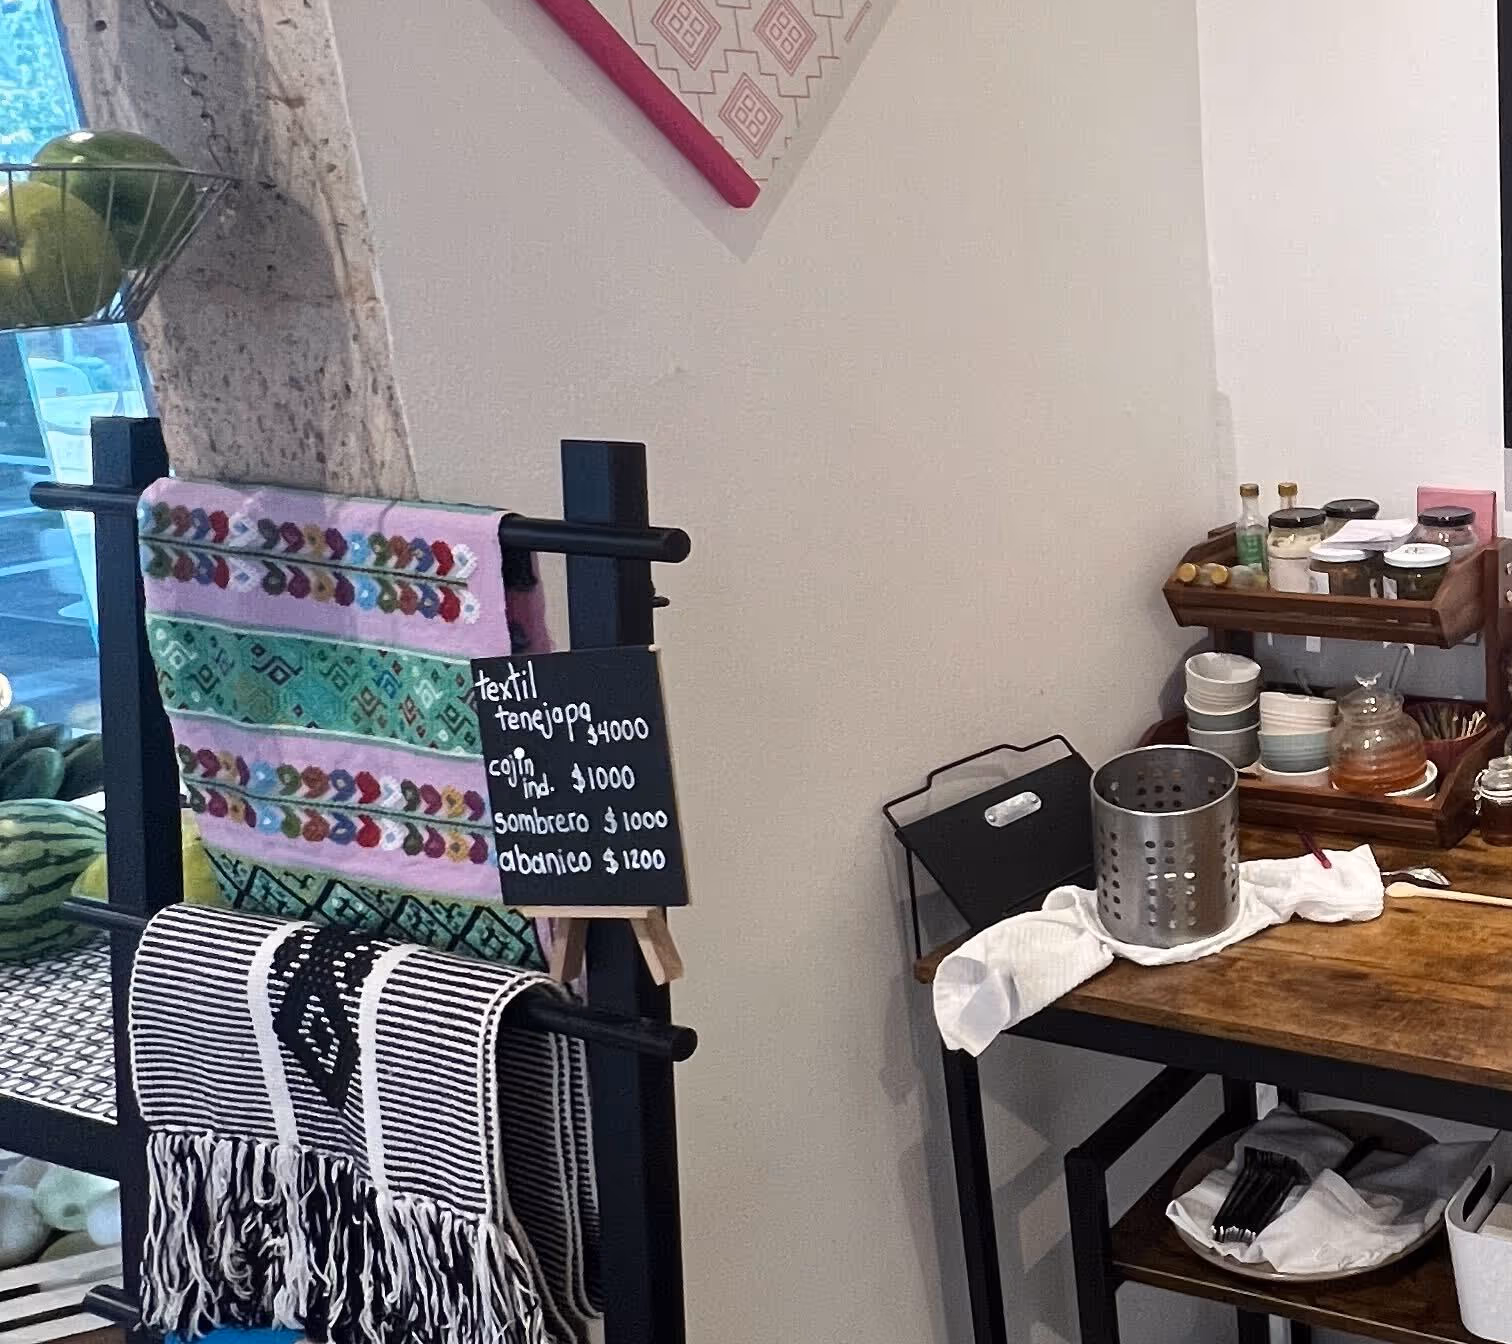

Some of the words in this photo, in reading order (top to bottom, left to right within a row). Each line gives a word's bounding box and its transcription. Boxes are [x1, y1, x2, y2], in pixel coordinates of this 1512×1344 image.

[475, 660, 538, 702] textil
[495, 701, 592, 742] tenejapa
[587, 717, 650, 746] $4000
[522, 772, 555, 799] ind.
[571, 763, 636, 794] $1000
[494, 806, 590, 835] sombrero
[499, 843, 592, 875] abanico
